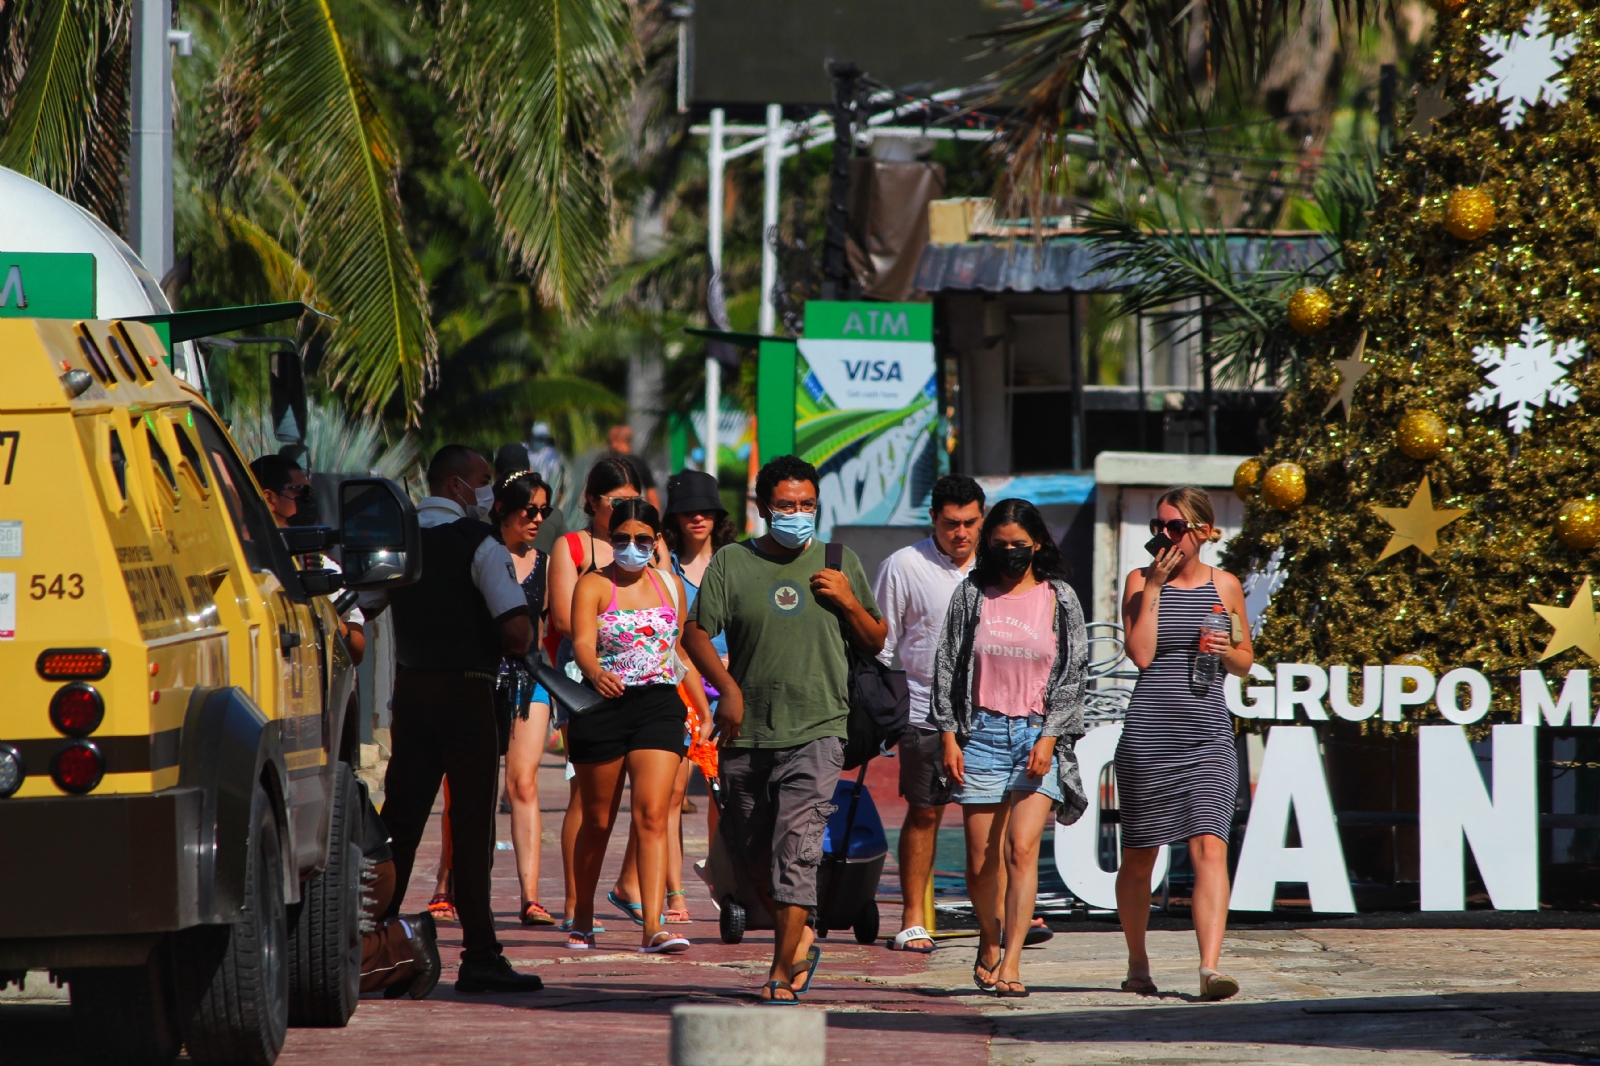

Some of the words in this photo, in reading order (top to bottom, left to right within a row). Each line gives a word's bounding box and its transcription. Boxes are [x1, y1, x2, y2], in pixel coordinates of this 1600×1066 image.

[842, 310, 909, 336] ATM
[839, 359, 904, 381] VISA
[0, 431, 20, 485] 7
[30, 573, 85, 600] 543
[985, 615, 1002, 625] ALL
[1005, 616, 1039, 640] THINGS
[990, 630, 1012, 638] WITH
[1223, 663, 1491, 724] GRUPO
[1520, 669, 1600, 727] M
